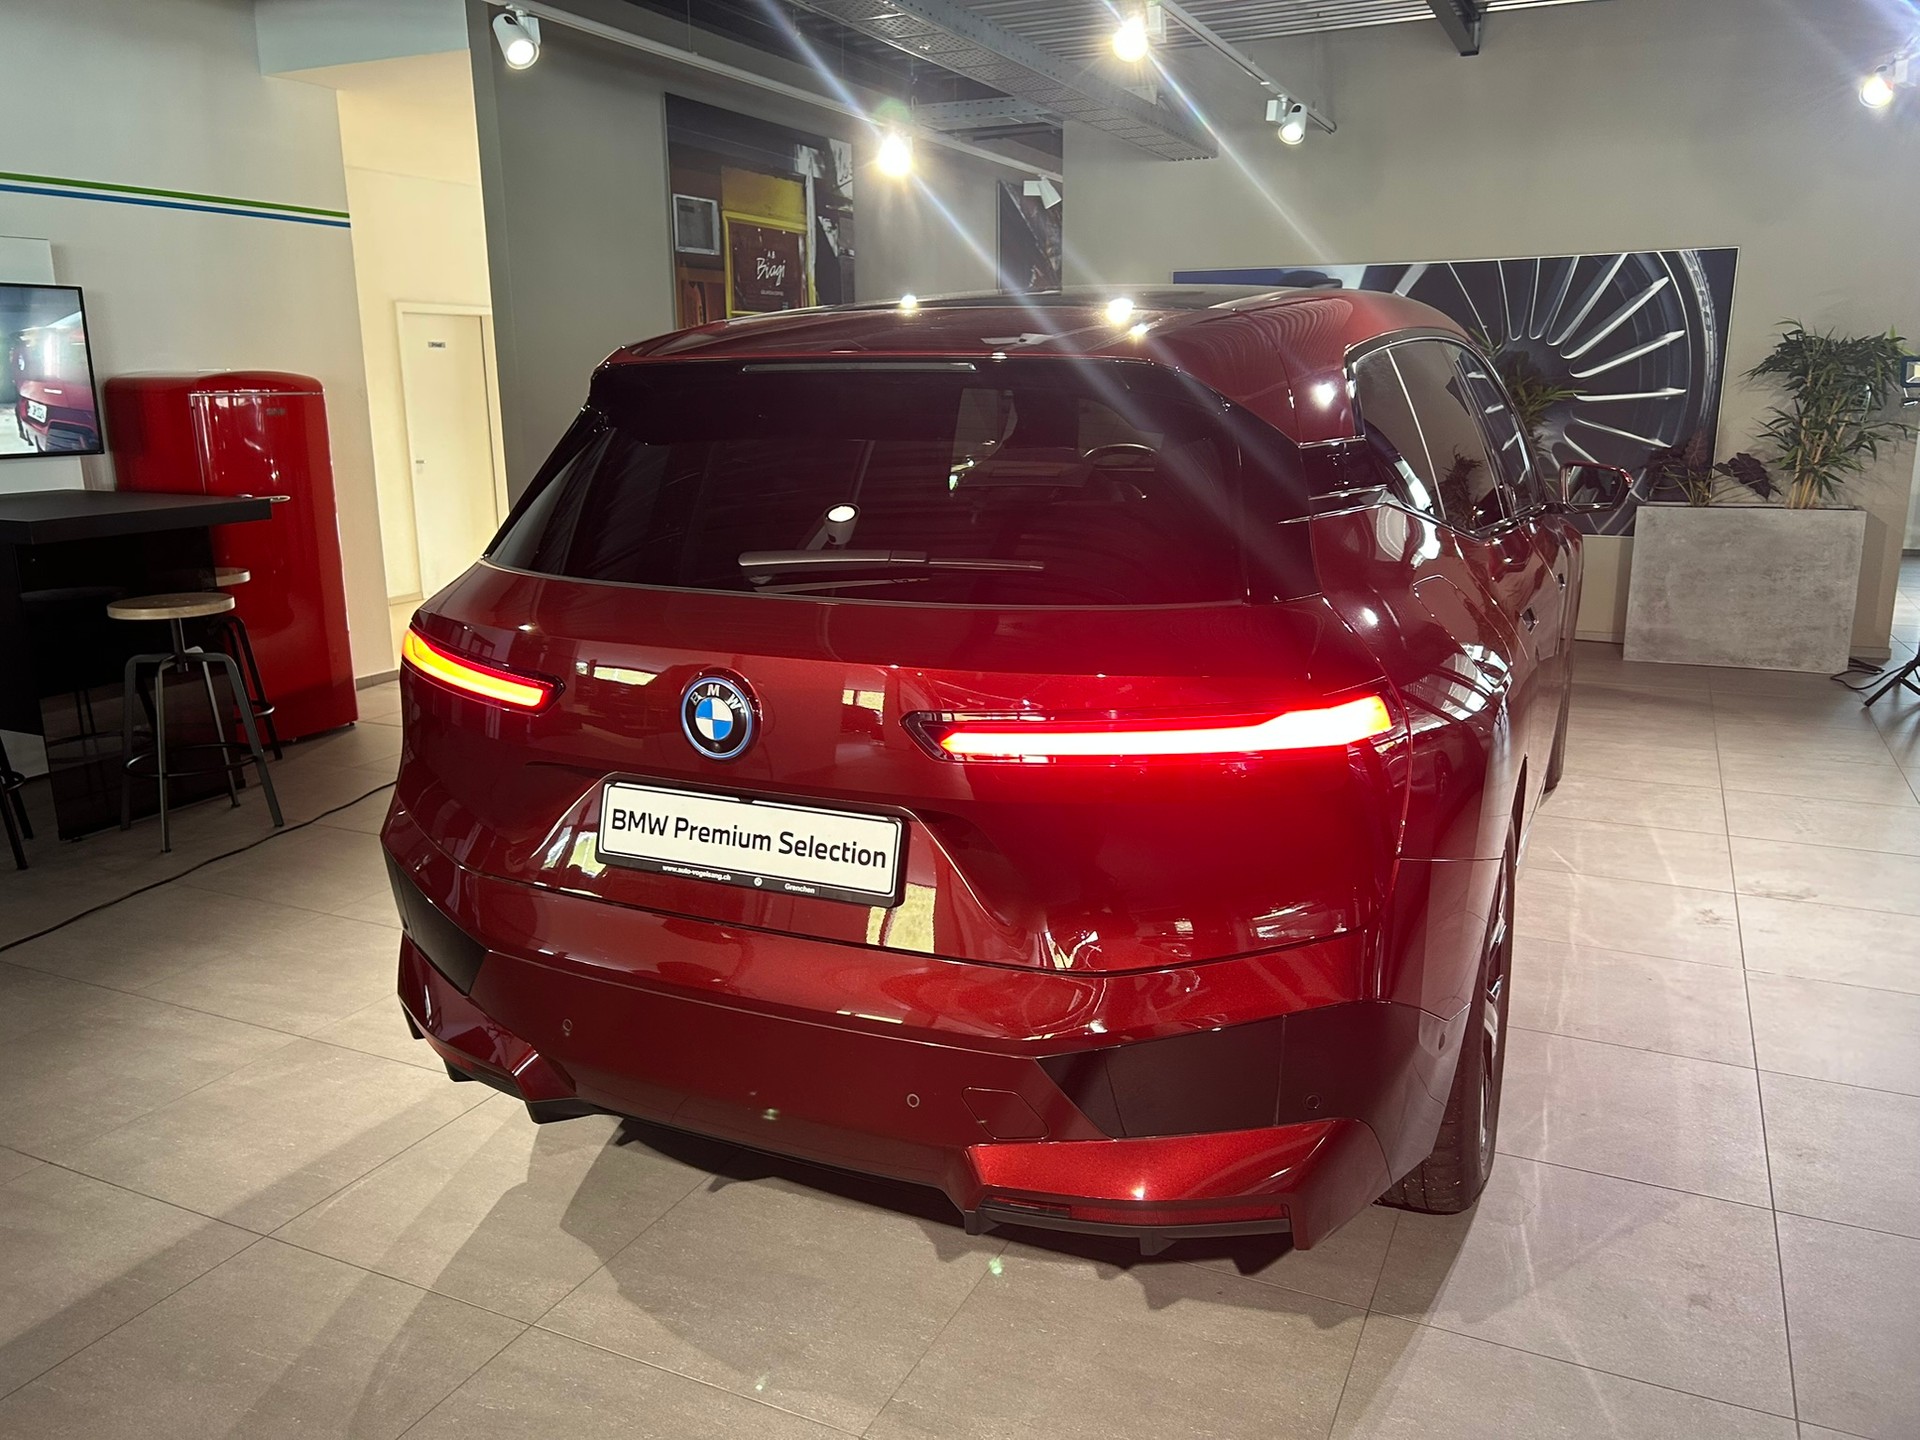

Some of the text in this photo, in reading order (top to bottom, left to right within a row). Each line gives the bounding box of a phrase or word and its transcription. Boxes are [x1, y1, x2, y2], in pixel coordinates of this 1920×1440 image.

[756, 257, 787, 287] Biagi
[689, 684, 743, 711] BMW
[611, 808, 887, 868] BMW Premium Selection
[662, 865, 816, 894] www.auto-vogelsang.ch Grenchen
